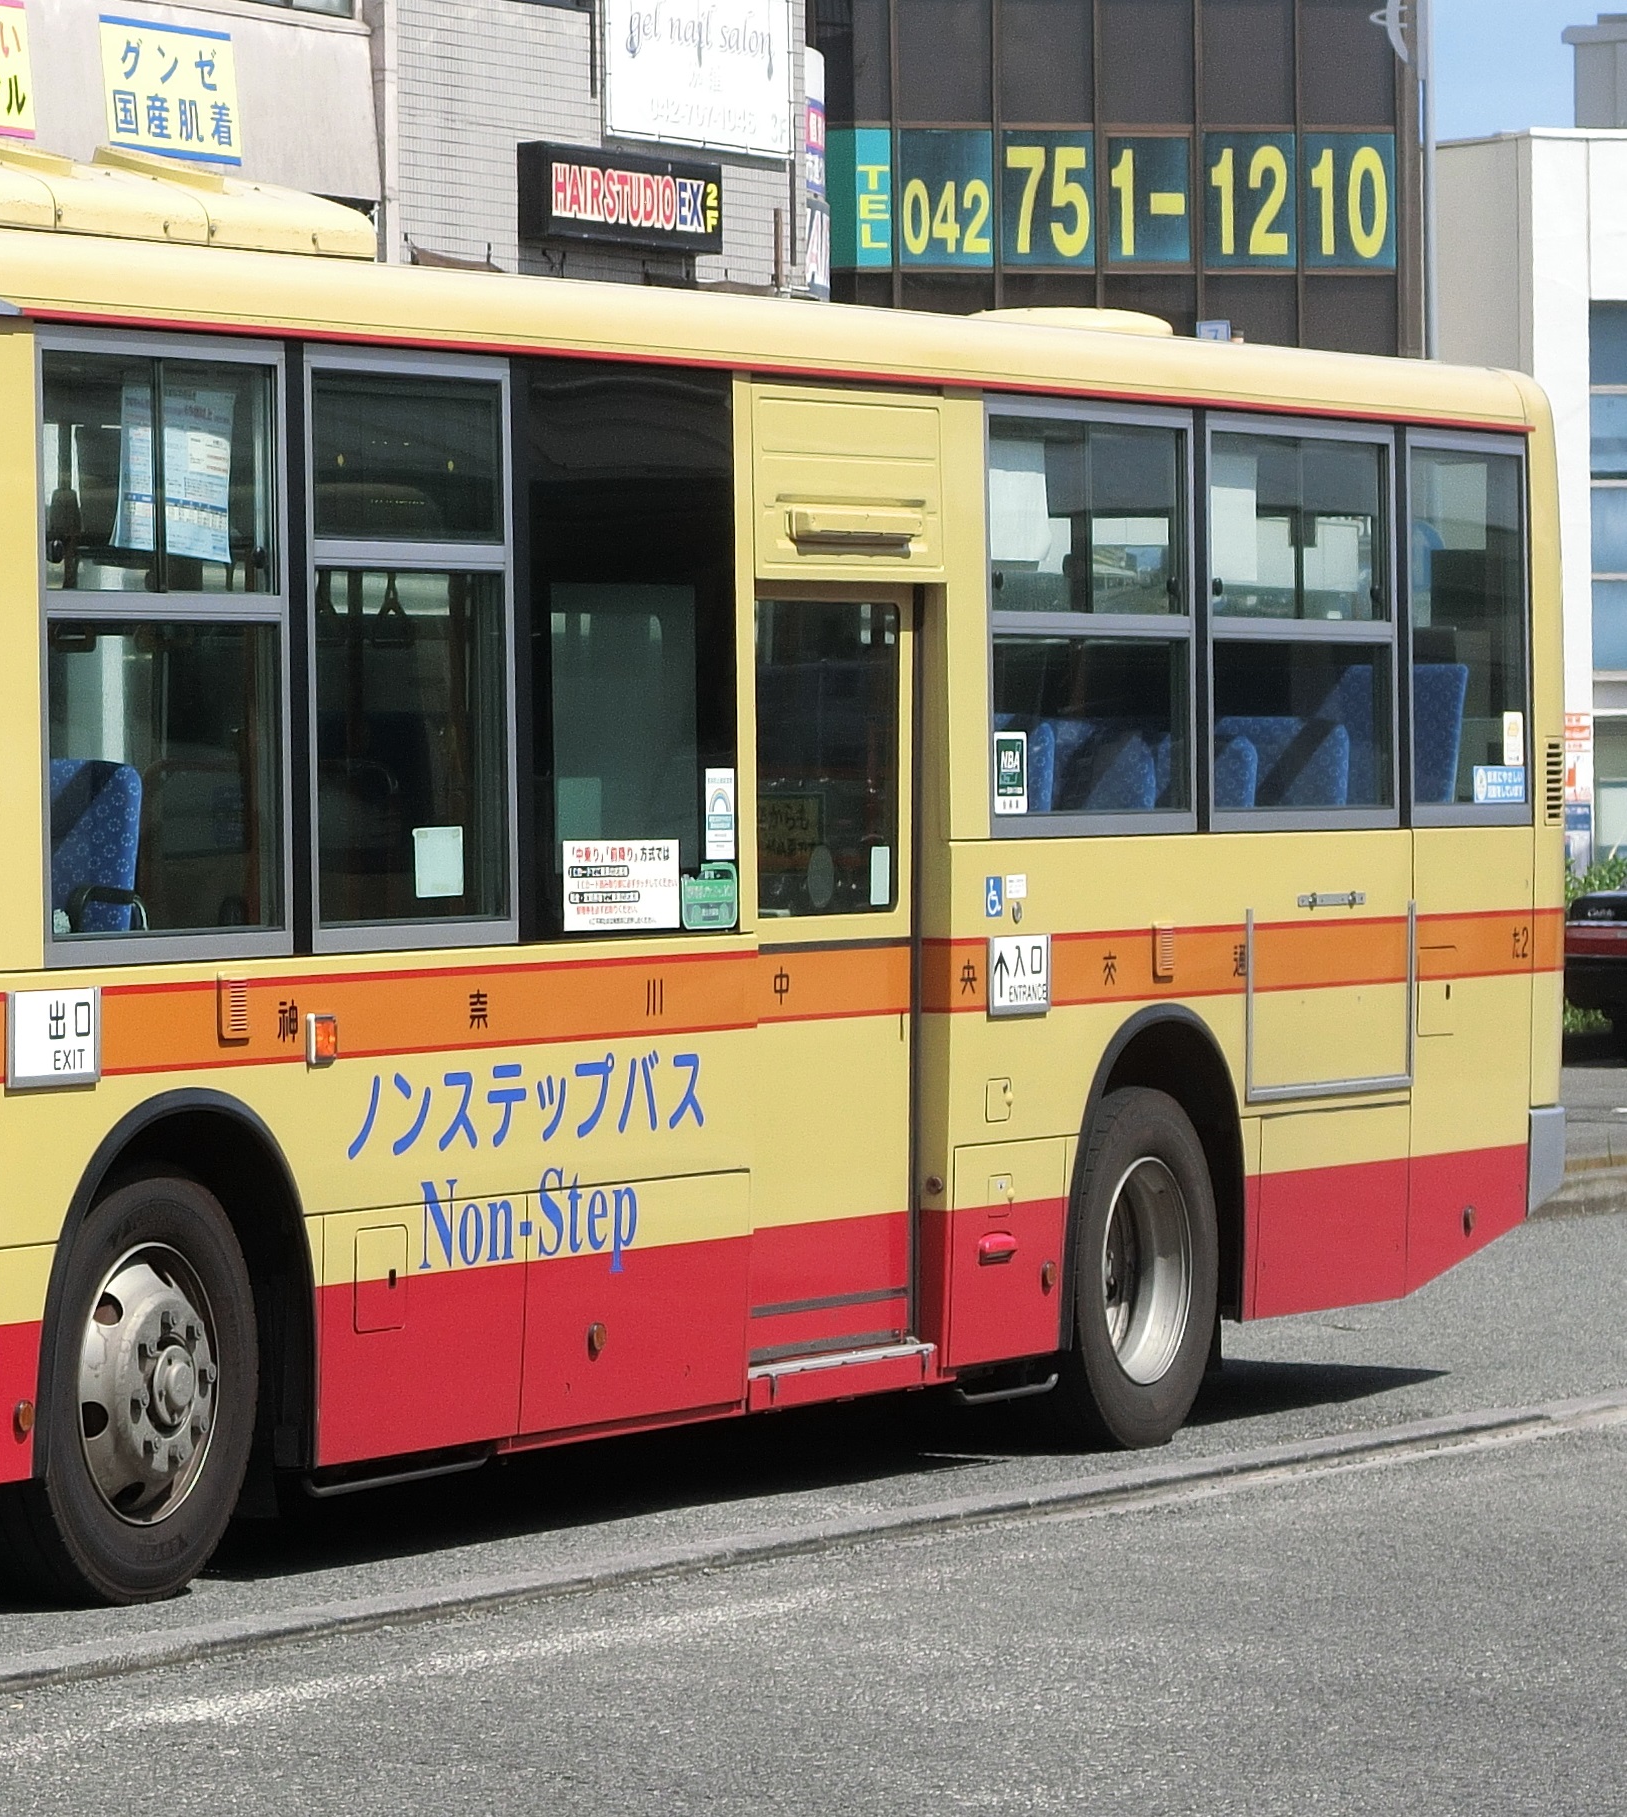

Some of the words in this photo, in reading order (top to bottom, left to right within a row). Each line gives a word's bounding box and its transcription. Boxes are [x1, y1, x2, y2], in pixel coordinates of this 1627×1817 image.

[626, 1, 662, 56] gel
[720, 12, 772, 54] salon
[121, 38, 217, 91] グンゼ
[113, 89, 232, 147] 国産肌着
[857, 165, 890, 248] TEL
[903, 178, 991, 255] 042
[1000, 750, 1021, 769] NBA
[1014, 946, 1043, 979] 入口
[1512, 926, 1529, 960] た2
[1008, 983, 1048, 1004] ENTRANCE
[49, 1000, 91, 1040] 出口
[54, 1048, 85, 1070] EXIT
[348, 1050, 705, 1160] ノンステップバス
[419, 1167, 638, 1273] Non-Step
